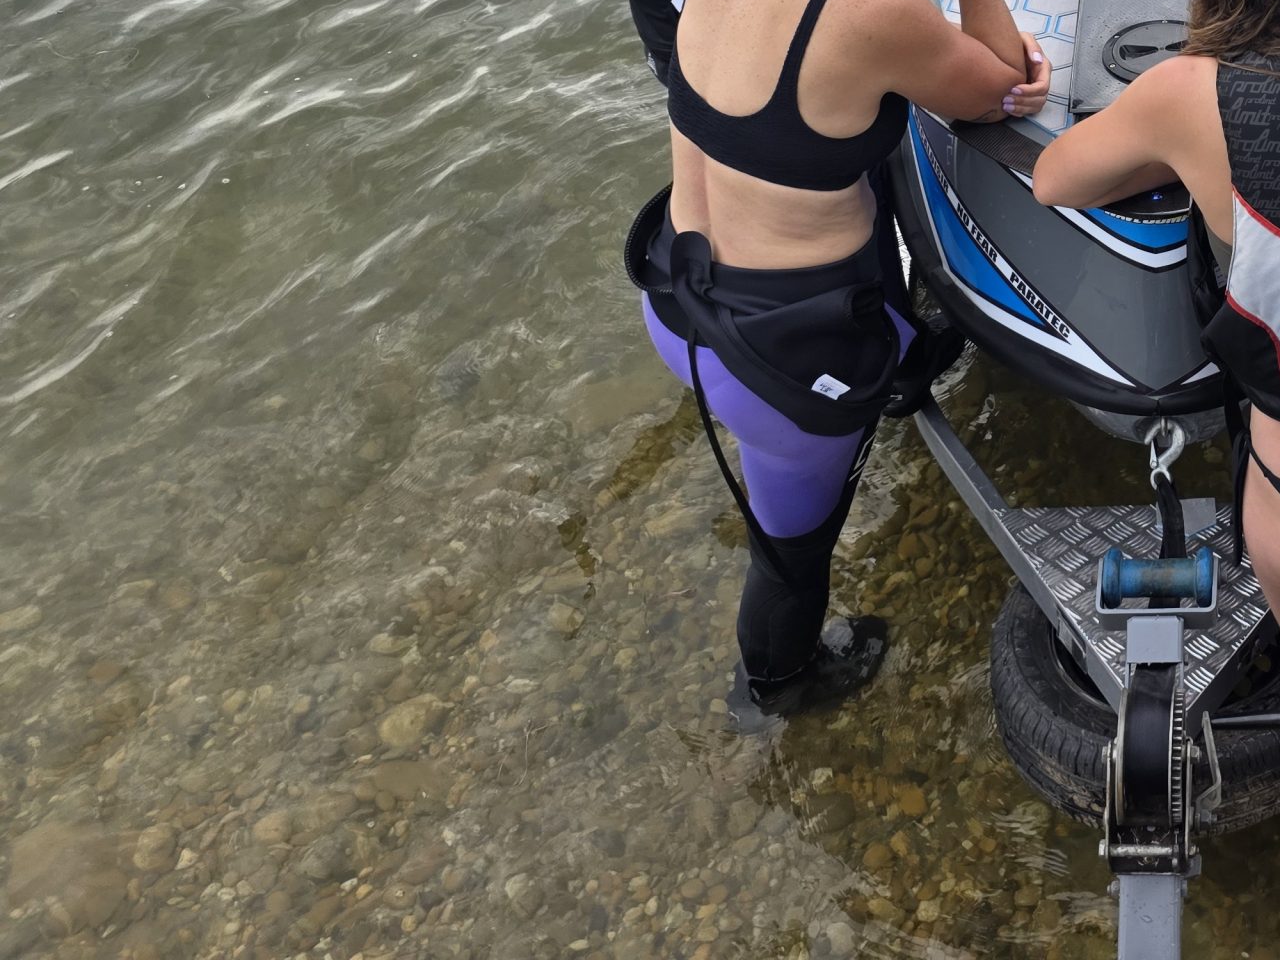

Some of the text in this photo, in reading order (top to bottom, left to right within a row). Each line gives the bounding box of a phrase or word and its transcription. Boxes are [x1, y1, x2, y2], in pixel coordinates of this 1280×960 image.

[956, 201, 1071, 339] NO FEAR PARATEC
